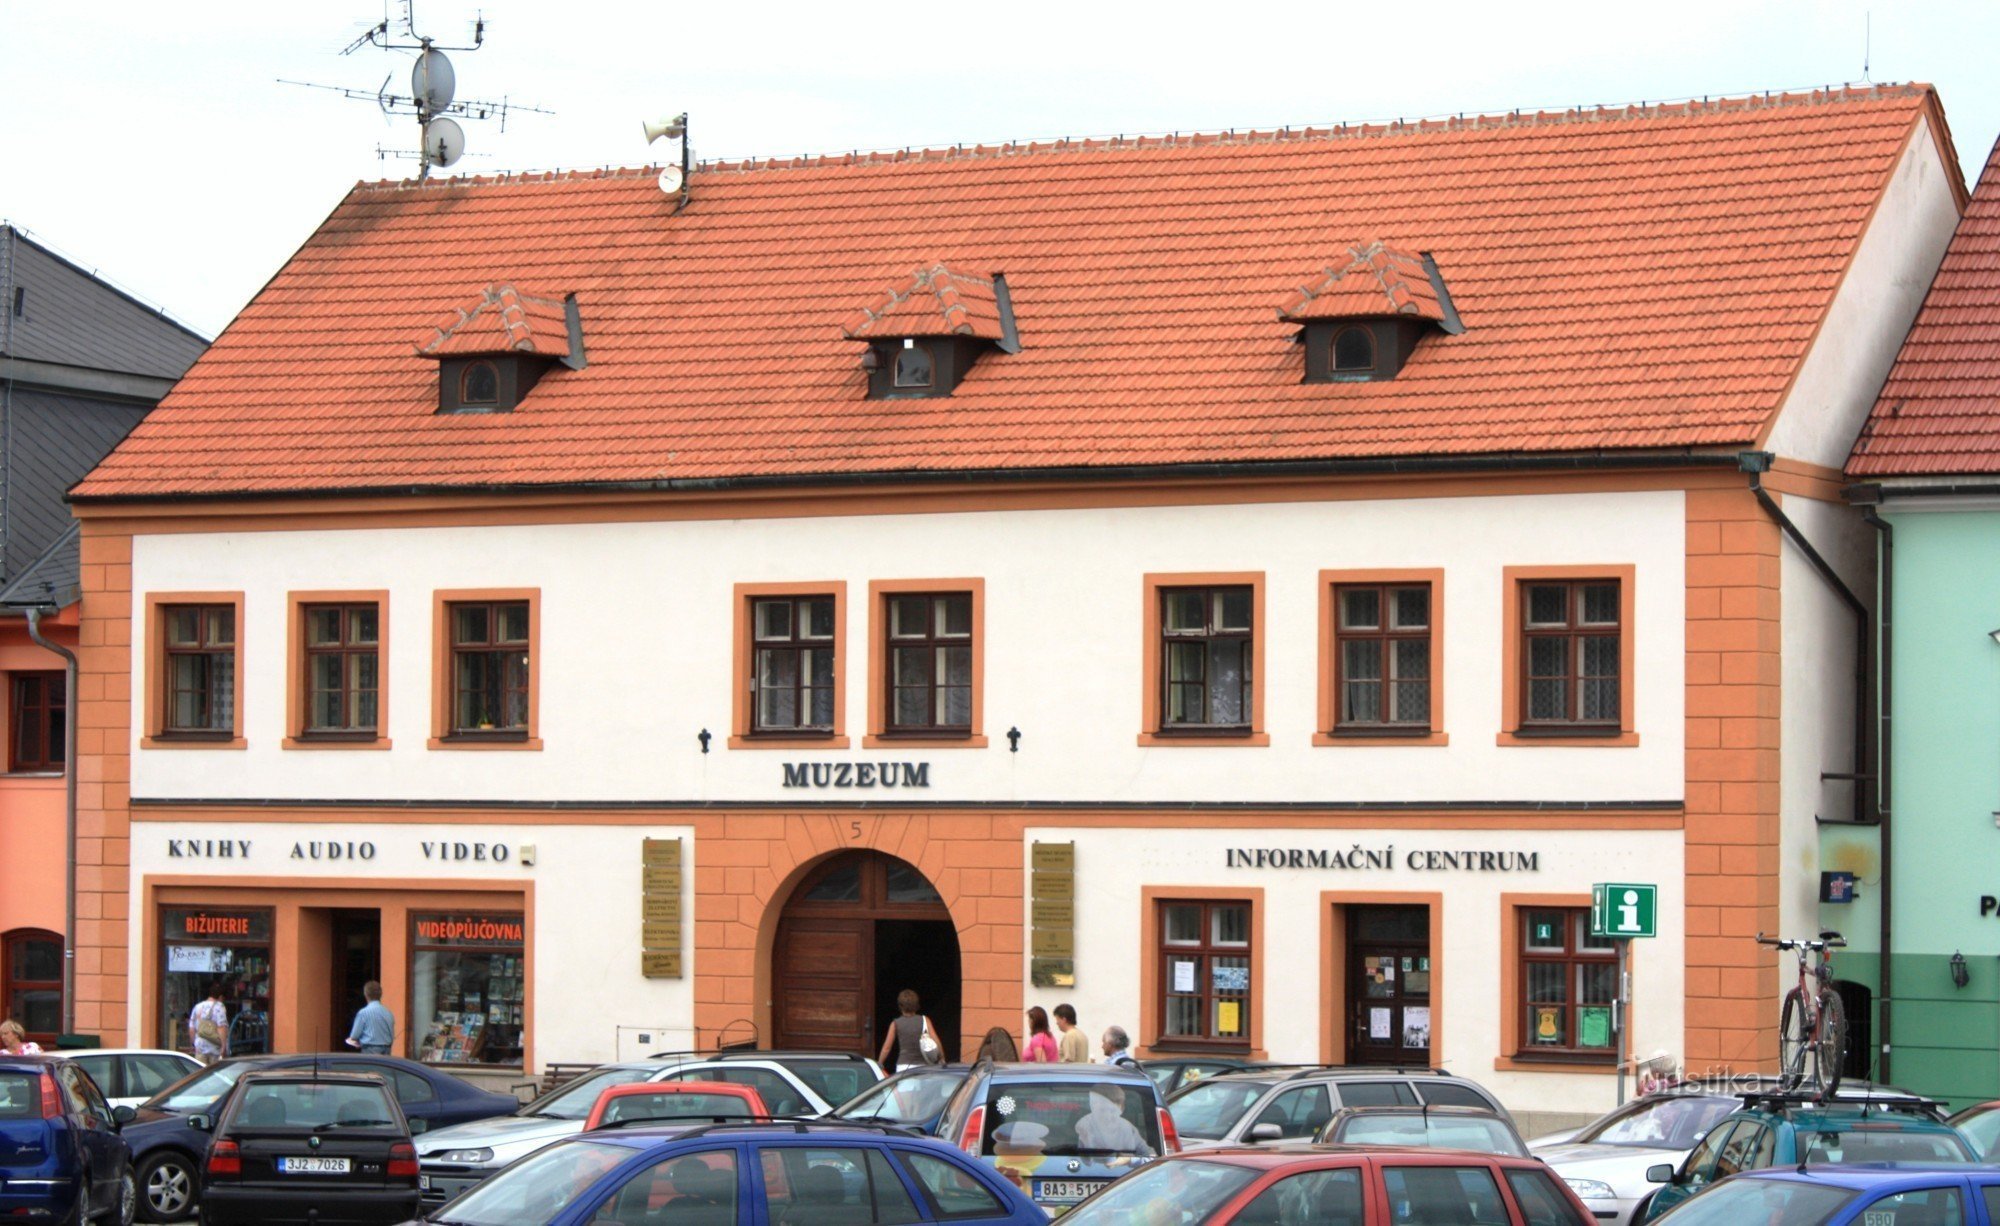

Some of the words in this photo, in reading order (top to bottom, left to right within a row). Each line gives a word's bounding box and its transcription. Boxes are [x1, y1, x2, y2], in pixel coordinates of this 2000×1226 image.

[782, 762, 930, 788] MUZEUM
[851, 821, 862, 839] 5
[168, 839, 252, 858] KNIHY
[291, 841, 375, 860] AUDIO
[421, 842, 509, 862] VIDEO
[1225, 844, 1394, 870] INFORMAČNÍ
[1407, 850, 1538, 871] CENTRUM
[186, 913, 249, 934] BIŽUTERIE
[417, 918, 523, 940] VIDEOPŮJČOVNA
[288, 1158, 309, 1170] 3J2
[317, 1159, 345, 1170] 7026
[1044, 1183, 1067, 1196] 8A3
